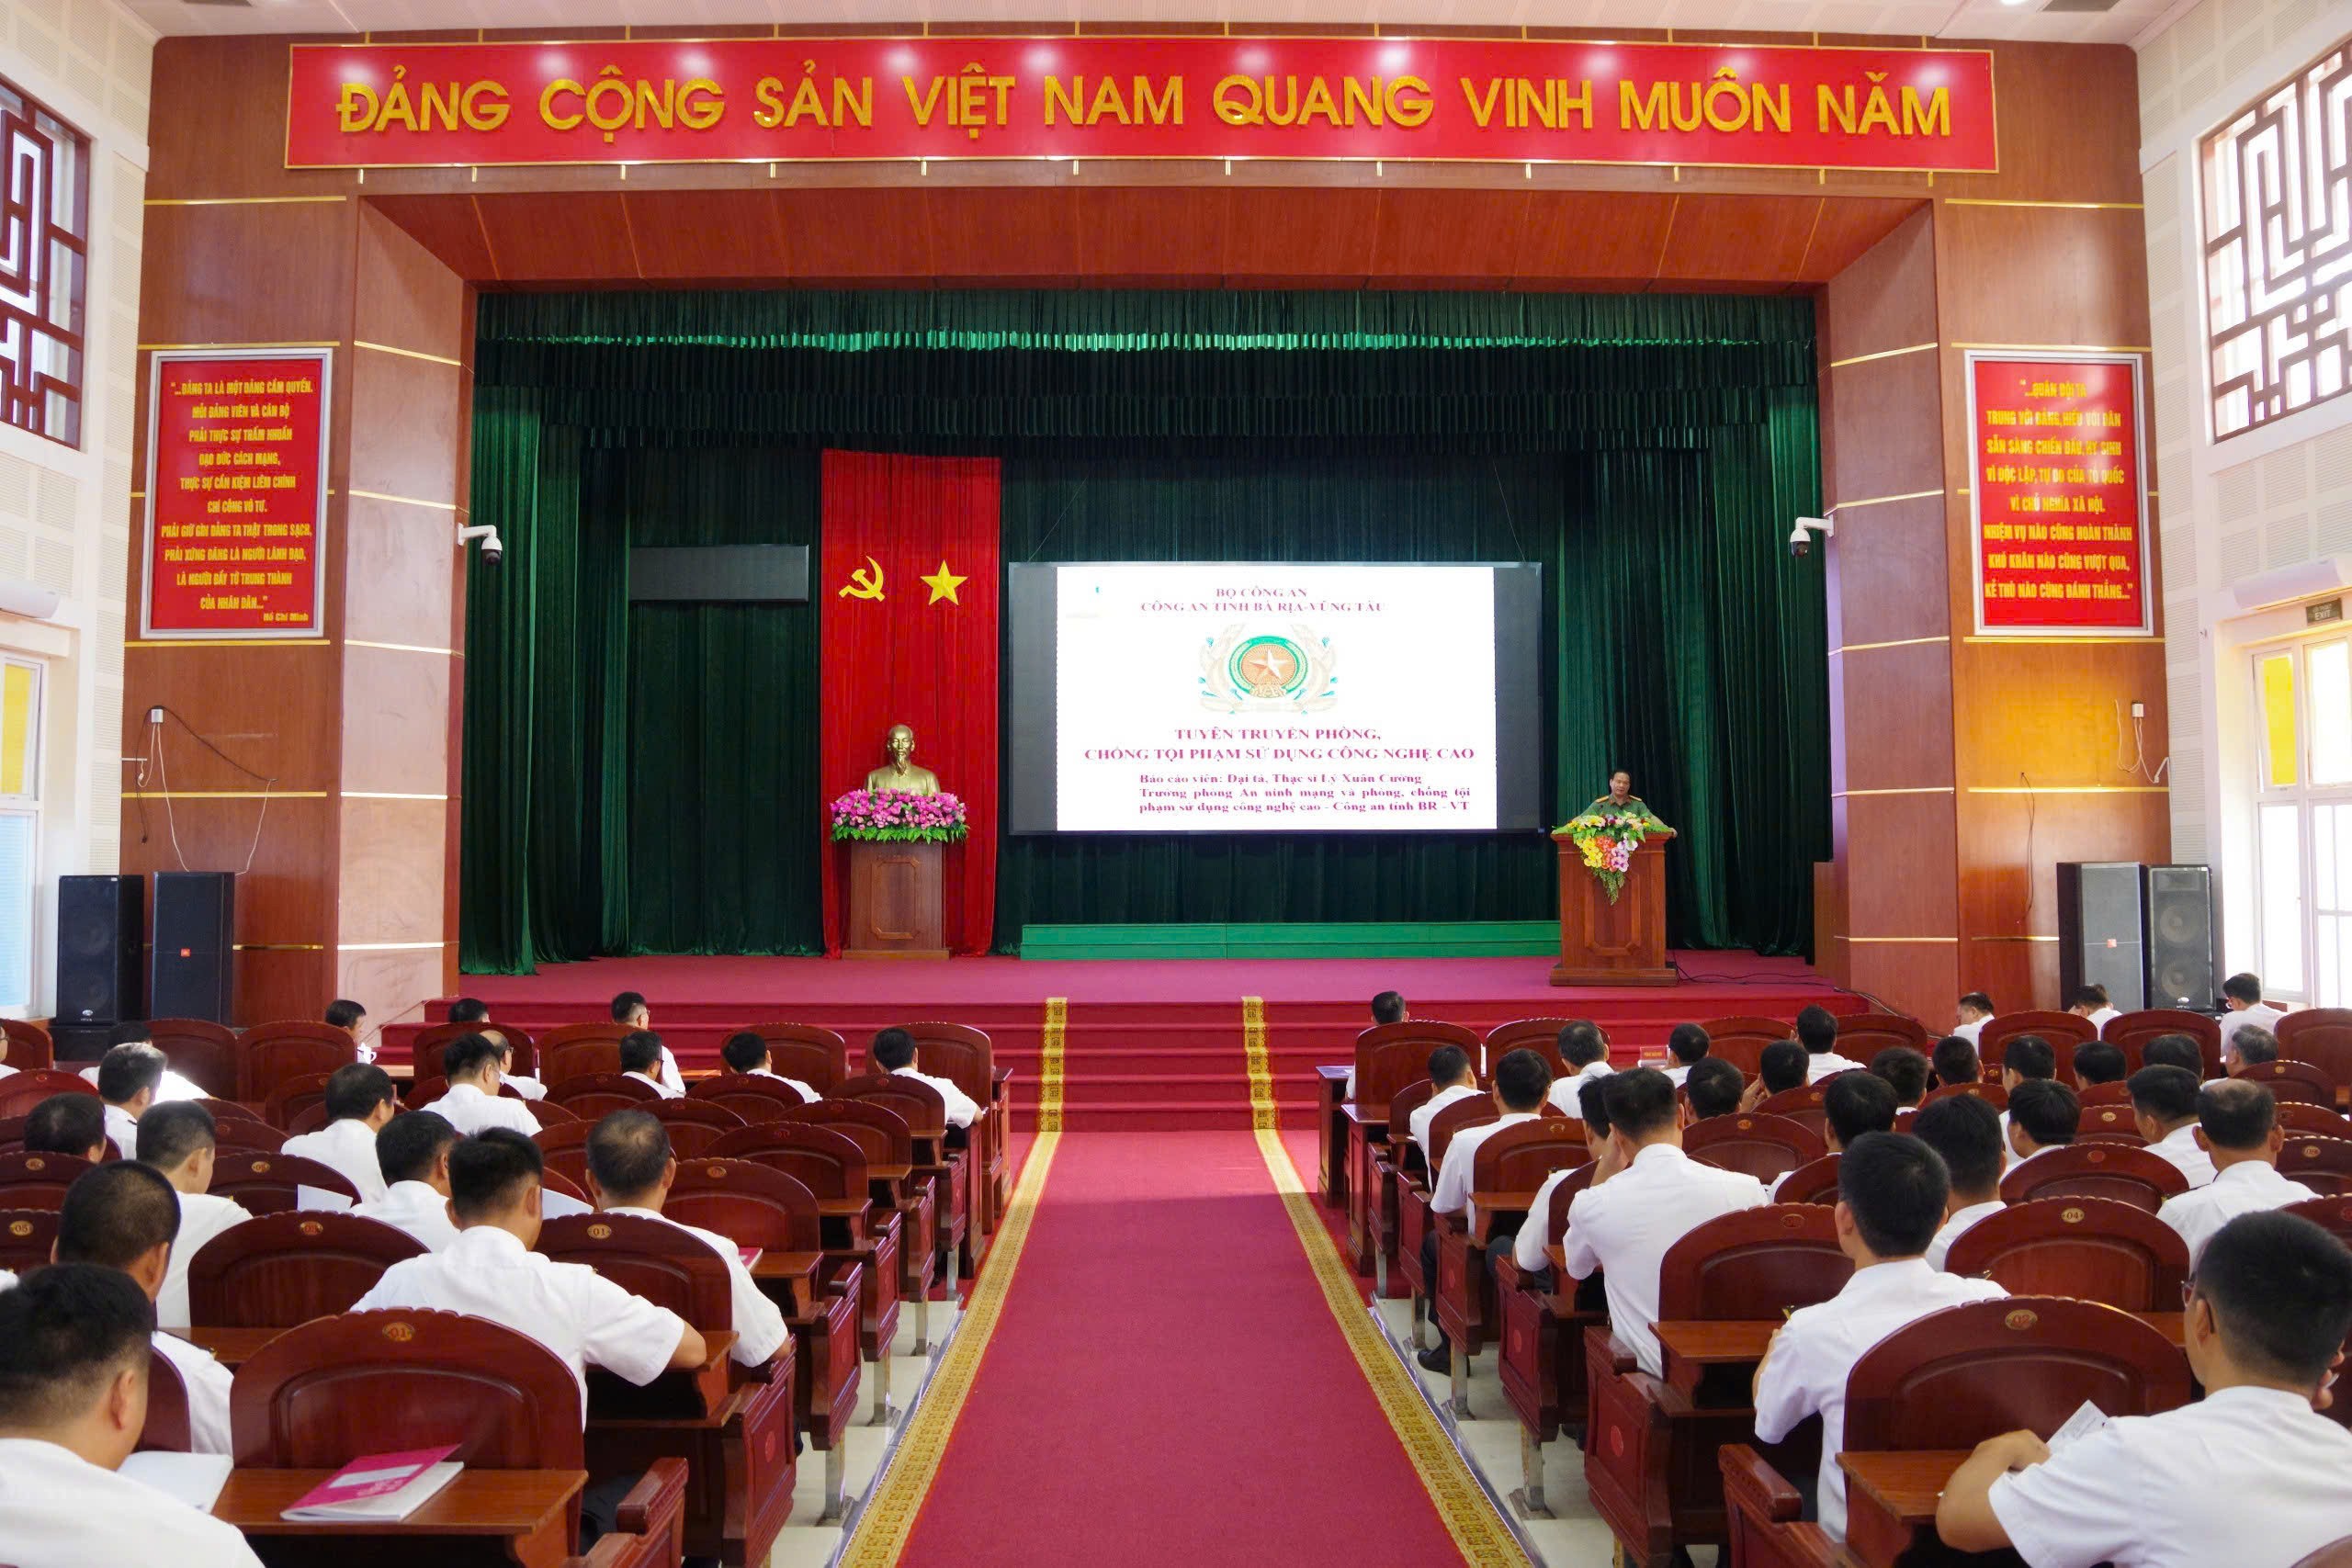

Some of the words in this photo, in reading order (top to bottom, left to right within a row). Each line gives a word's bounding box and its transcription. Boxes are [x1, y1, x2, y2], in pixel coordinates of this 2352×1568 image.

[335, 64, 511, 133] ĐẢNG
[539, 65, 725, 143] CỘNG
[754, 59, 873, 129] SẢN
[901, 63, 1015, 139] VIỆT
[1044, 75, 1184, 125] NAM
[1213, 73, 1433, 128] QUANG
[1462, 77, 1592, 130] VINH
[1620, 67, 1792, 133] MUÔN
[1817, 72, 1951, 136] NĂM
[215, 380, 224, 394] LÀ
[1216, 588, 1237, 599] BỘ
[1240, 586, 1283, 597] CÔNG
[1289, 588, 1307, 597] AN
[1140, 600, 1183, 612] CÔNG
[1190, 603, 1208, 612] AN
[2315, 610, 2331, 620] EXIT
[1175, 726, 1234, 739] TUYÊN
[1316, 726, 1382, 740] PHÒNG,
[1190, 749, 1240, 761] PHẠM
[1273, 749, 1322, 761] DỤNG
[1328, 746, 1378, 759] CÔNG
[1437, 749, 1475, 759] CAO
[1240, 788, 1258, 797] An
[1265, 788, 1293, 797] ninh
[1332, 801, 1366, 812] Công
[1419, 801, 1438, 810] BR
[1450, 801, 1469, 810] VT
[2065, 1212, 2081, 1222] 04
[15, 1224, 30, 1234] 05
[593, 1226, 607, 1235] 01
[2012, 1314, 2030, 1327] 02
[389, 1325, 408, 1337] 01
